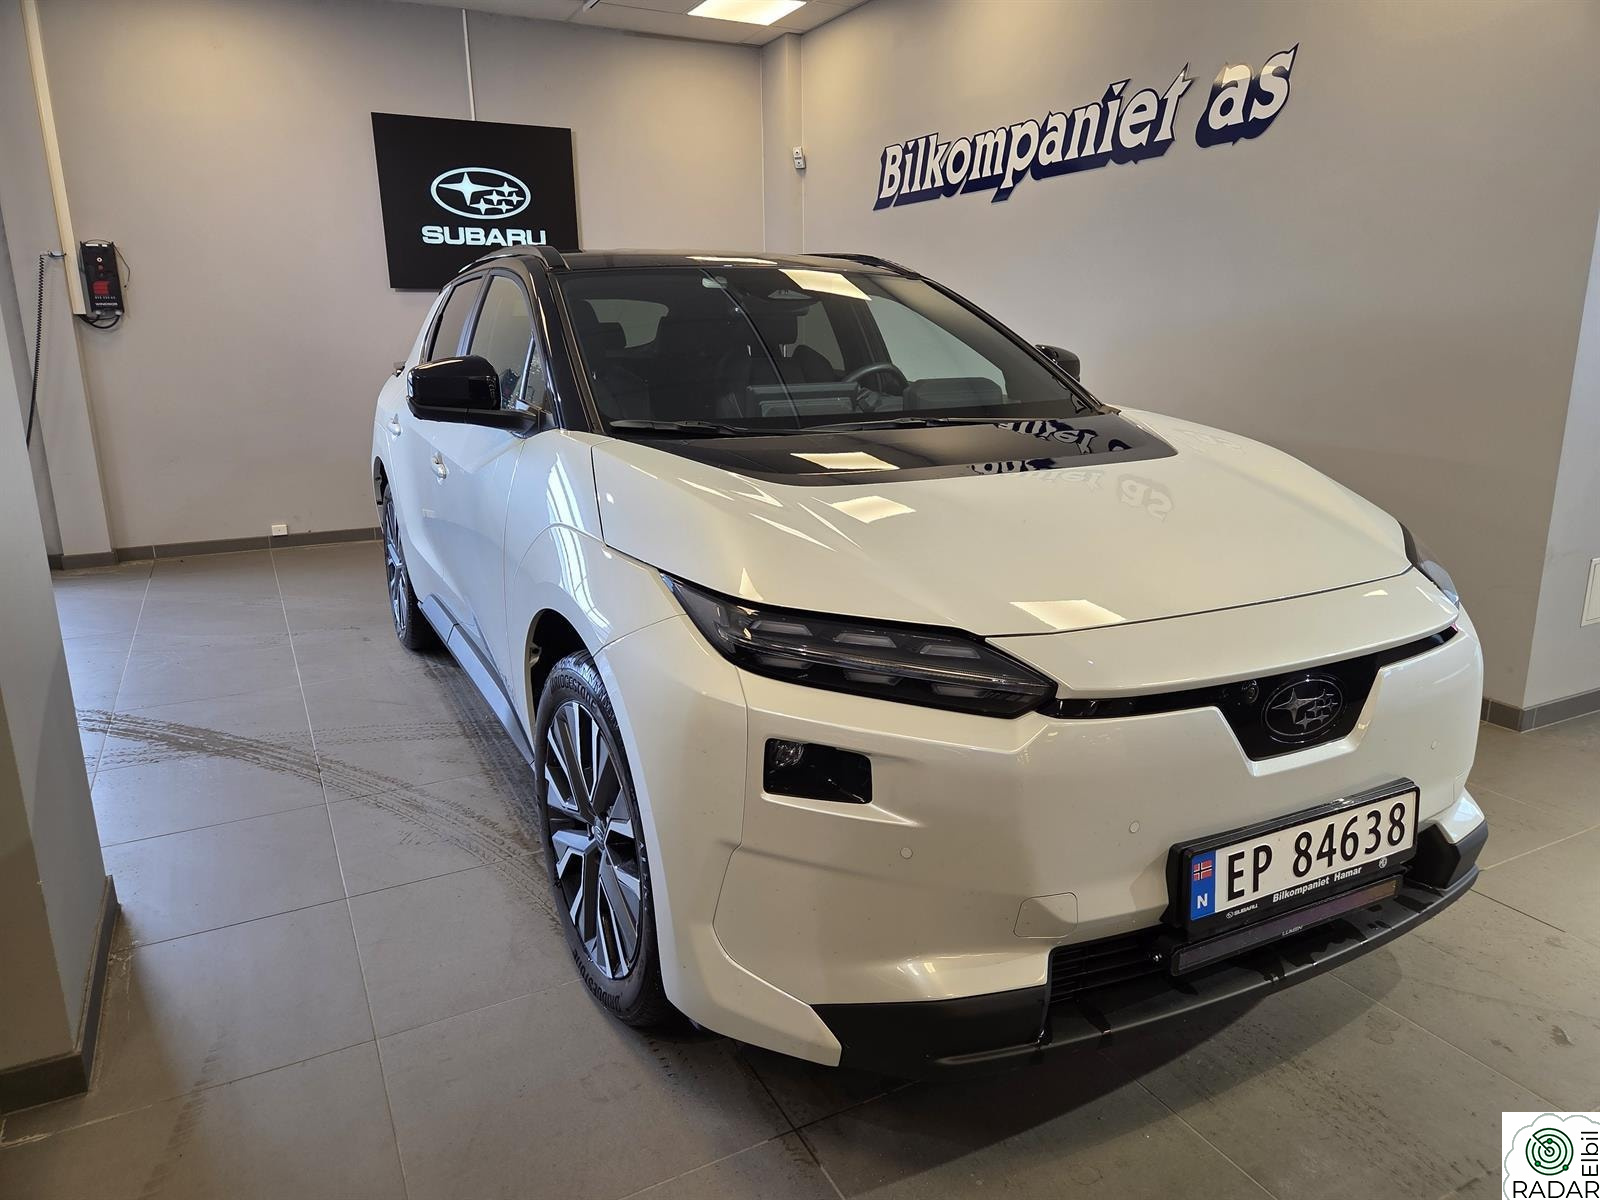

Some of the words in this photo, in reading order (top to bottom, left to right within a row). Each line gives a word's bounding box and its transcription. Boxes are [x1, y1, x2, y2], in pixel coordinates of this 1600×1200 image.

[875, 66, 1195, 206] Bilkompaniet
[1200, 44, 1298, 142] as
[421, 225, 547, 247] SUBARU
[1227, 844, 1273, 902] EP
[1292, 802, 1406, 878] 84638
[1197, 893, 1208, 910] N
[1272, 876, 1331, 903] Bilkompaniet
[1333, 866, 1363, 882] Hamar
